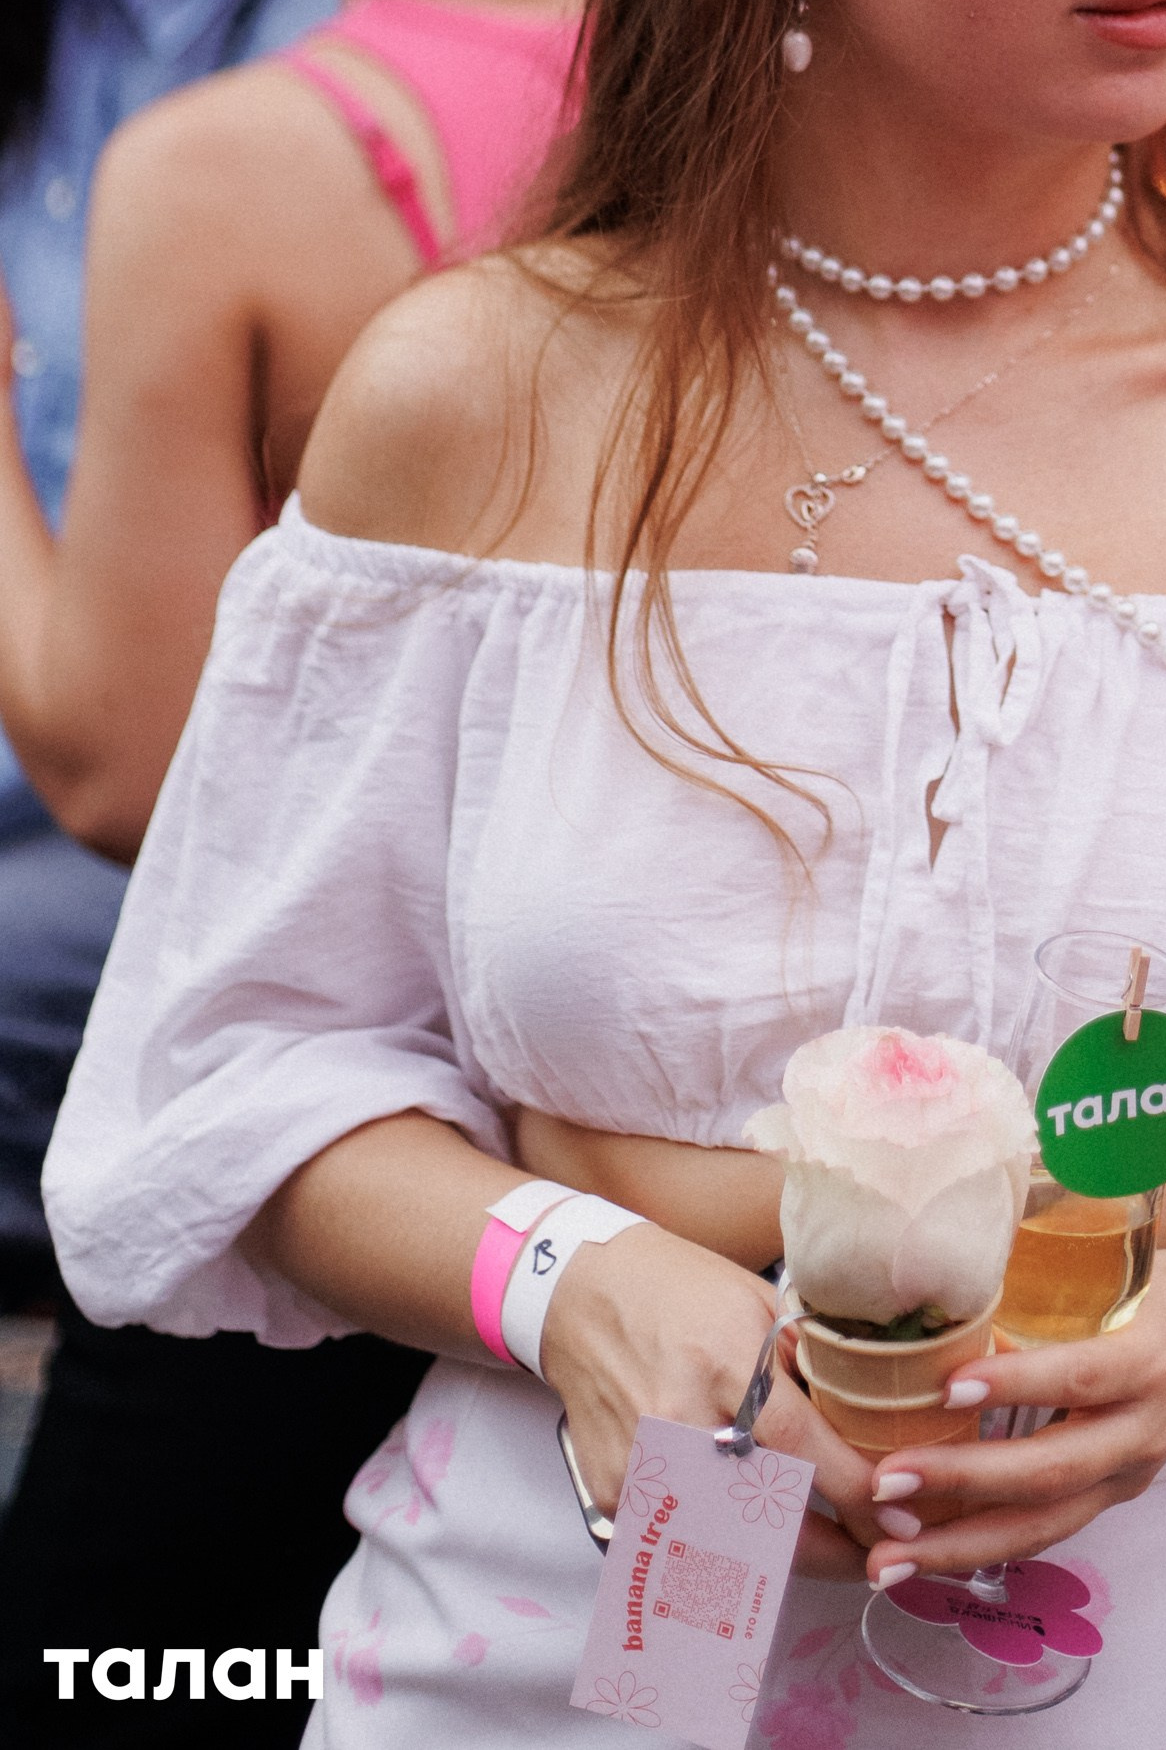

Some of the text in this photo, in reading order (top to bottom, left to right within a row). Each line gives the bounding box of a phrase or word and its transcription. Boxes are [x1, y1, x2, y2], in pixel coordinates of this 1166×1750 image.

[622, 1494, 679, 1652] banana tree
[744, 1574, 768, 1640] ЭТО ЦВЕТЫ
